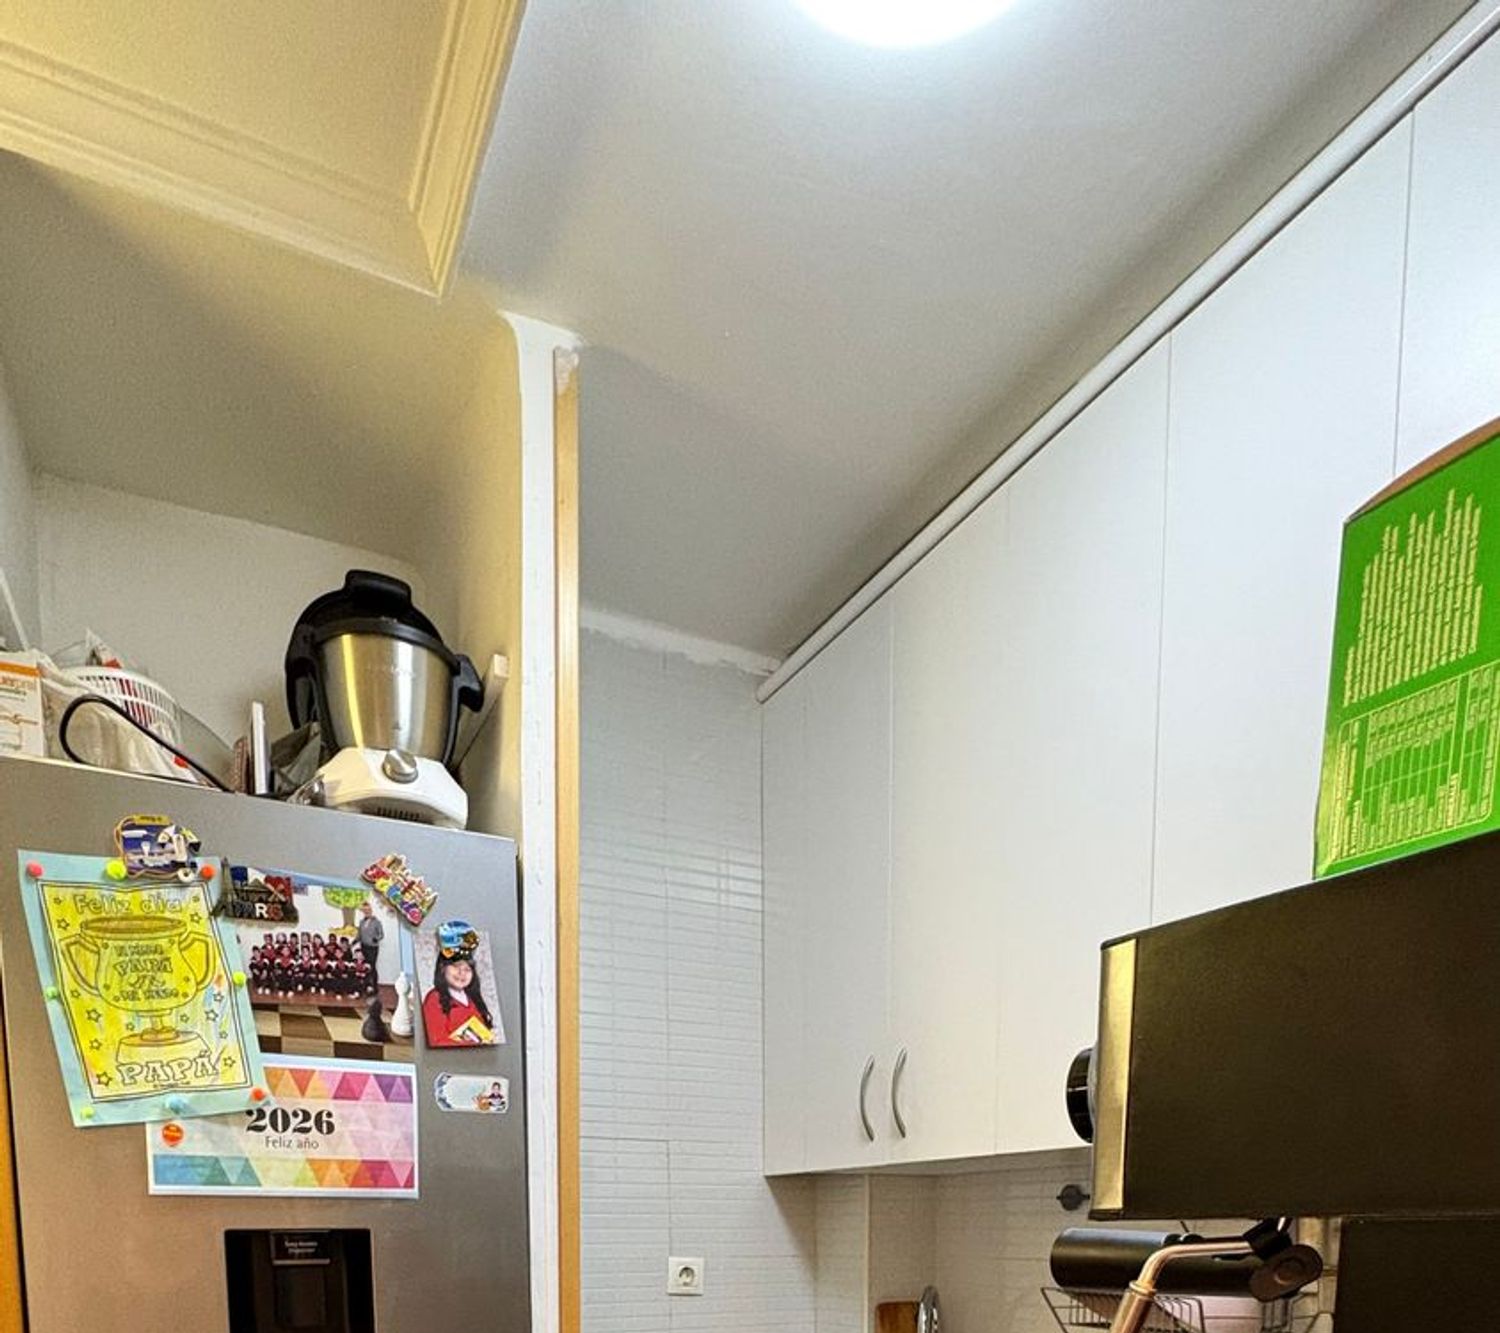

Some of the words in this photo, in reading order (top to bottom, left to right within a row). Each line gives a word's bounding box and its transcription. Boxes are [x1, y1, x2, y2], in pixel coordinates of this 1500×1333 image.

[73, 892, 132, 914] Feliz
[116, 1050, 218, 1085] PAPÁ
[245, 1107, 336, 1136] 2026
[265, 1136, 293, 1148] Feliz
[297, 1137, 320, 1149] año
